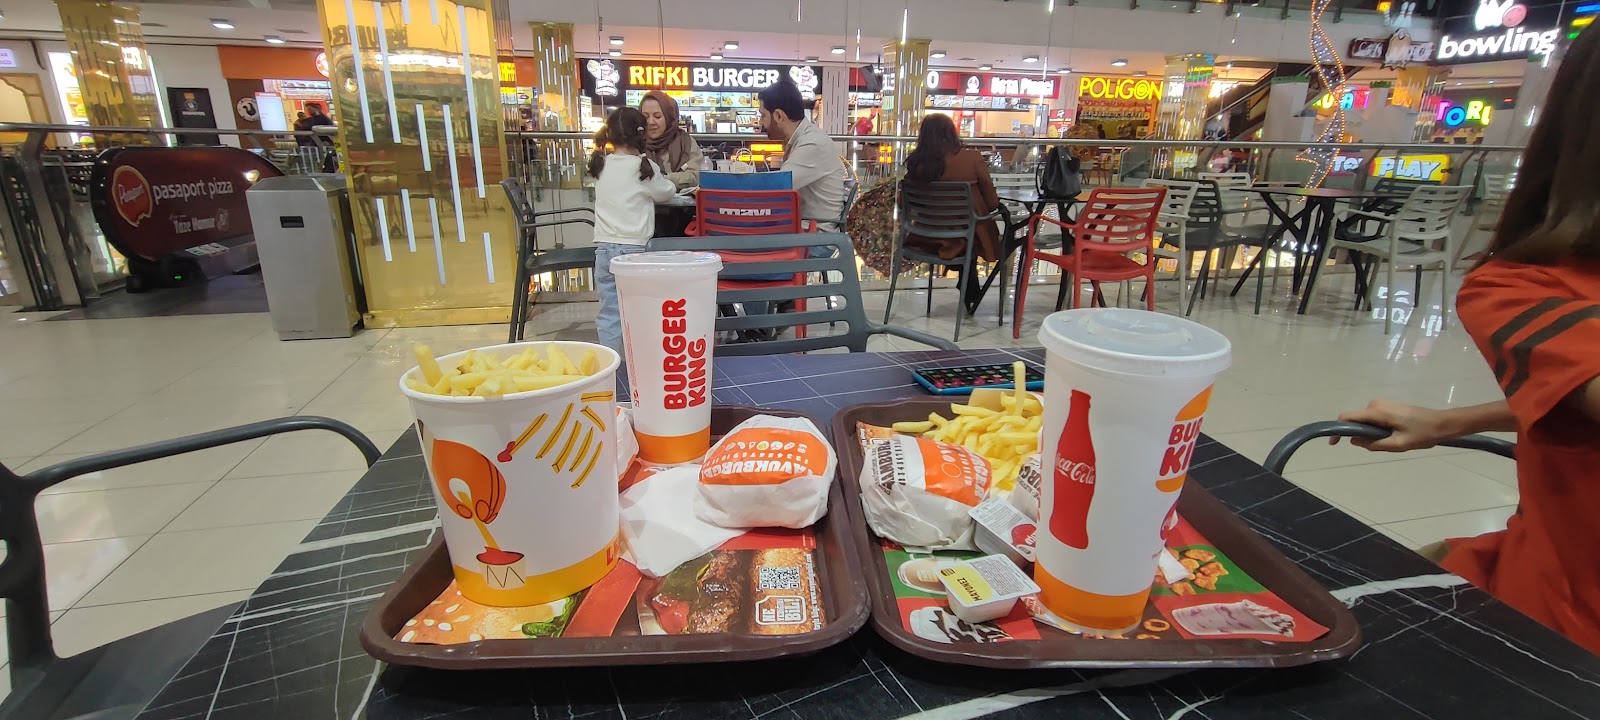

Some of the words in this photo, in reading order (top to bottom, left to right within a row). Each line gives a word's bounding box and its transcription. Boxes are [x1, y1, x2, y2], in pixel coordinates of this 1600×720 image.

[1438, 27, 1559, 61] bowling
[629, 65, 689, 86] RIFKI
[693, 66, 780, 88] BURGER
[1379, 157, 1442, 179] PLAY
[153, 179, 207, 205] pasaport
[208, 177, 234, 199] pizza
[662, 298, 687, 410] BURGER
[688, 338, 706, 408] KING
[703, 460, 814, 480] AVUKBURGE
[956, 576, 983, 602] MAYONEZ
[762, 608, 776, 622] NE
